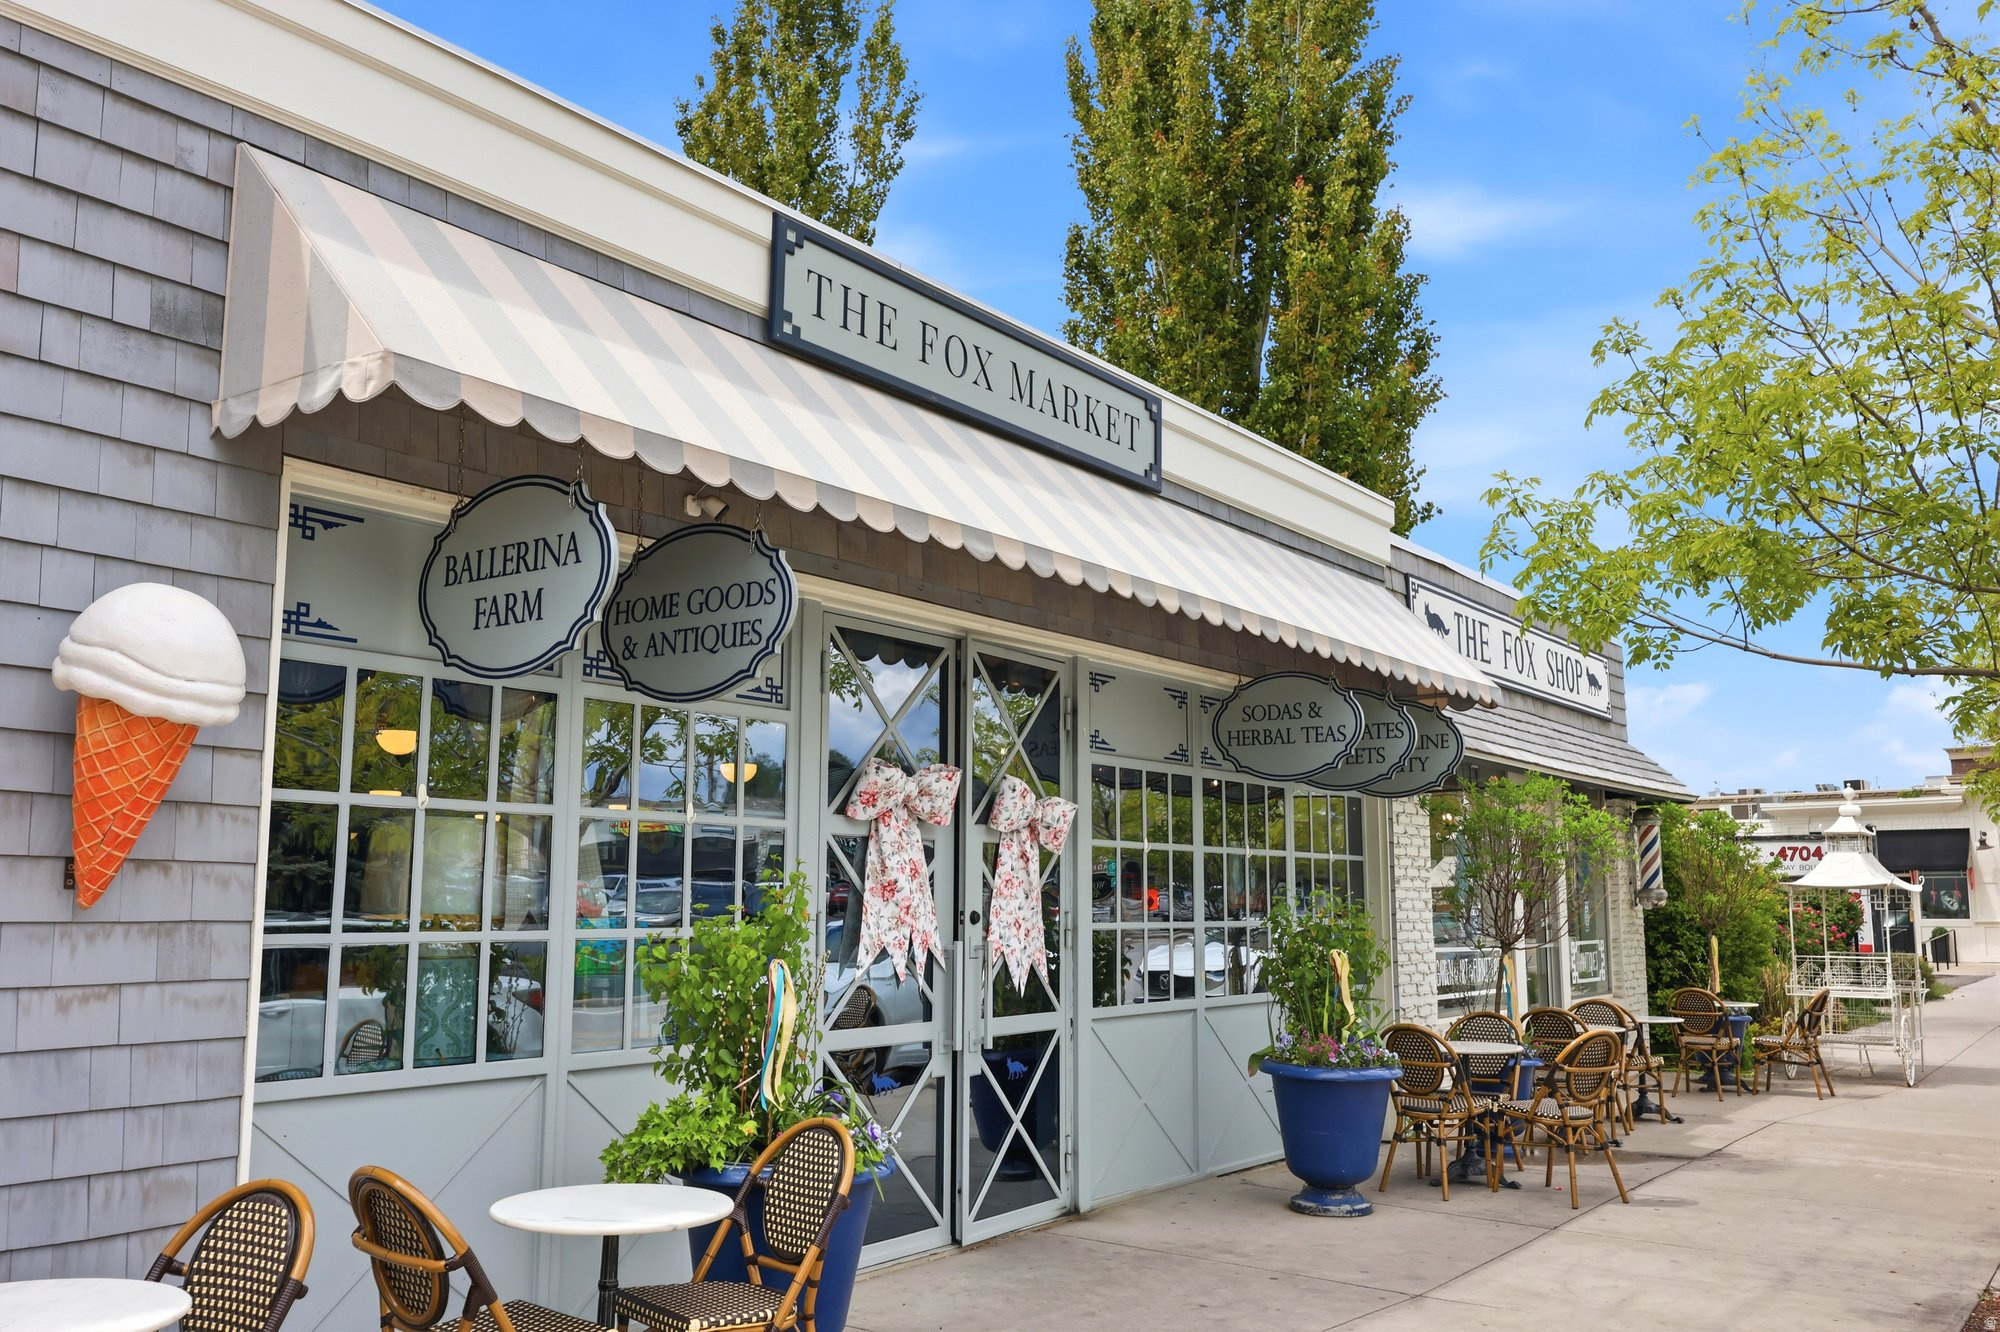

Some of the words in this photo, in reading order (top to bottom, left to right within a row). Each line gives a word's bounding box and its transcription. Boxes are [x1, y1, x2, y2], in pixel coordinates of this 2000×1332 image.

[807, 269, 898, 351] THE
[919, 320, 994, 393] FOX
[1009, 360, 1140, 453] MARKET
[444, 531, 582, 587] BALLERINA
[473, 588, 544, 630] FARM
[614, 592, 680, 626] HOME
[686, 578, 776, 615] GOODS
[622, 635, 638, 660] &
[643, 619, 763, 658] ANTIQUES
[1453, 611, 1491, 665] THE
[1501, 630, 1537, 680] FOX
[1546, 648, 1583, 695] SHOP
[1242, 702, 1302, 723] SODAS
[1308, 701, 1323, 718] &
[1227, 727, 1296, 747] HERBAL
[1300, 724, 1347, 744] TEAS
